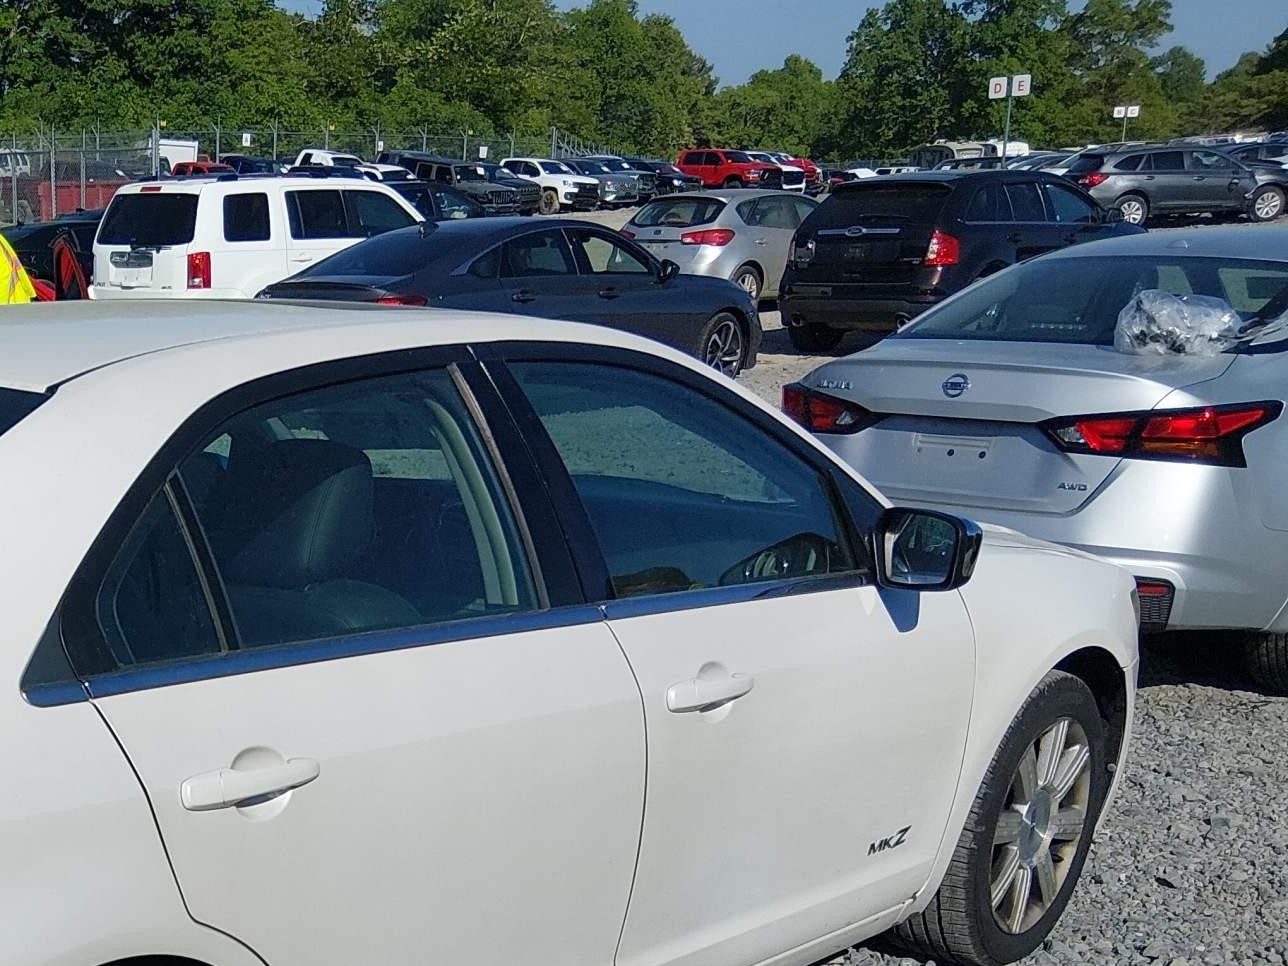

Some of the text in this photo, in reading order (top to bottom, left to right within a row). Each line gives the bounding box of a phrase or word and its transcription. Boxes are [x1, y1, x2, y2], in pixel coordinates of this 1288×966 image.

[994, 83, 1002, 94] D
[1017, 80, 1025, 91] E
[1056, 482, 1088, 491] AWD
[867, 825, 912, 856] MKZ
